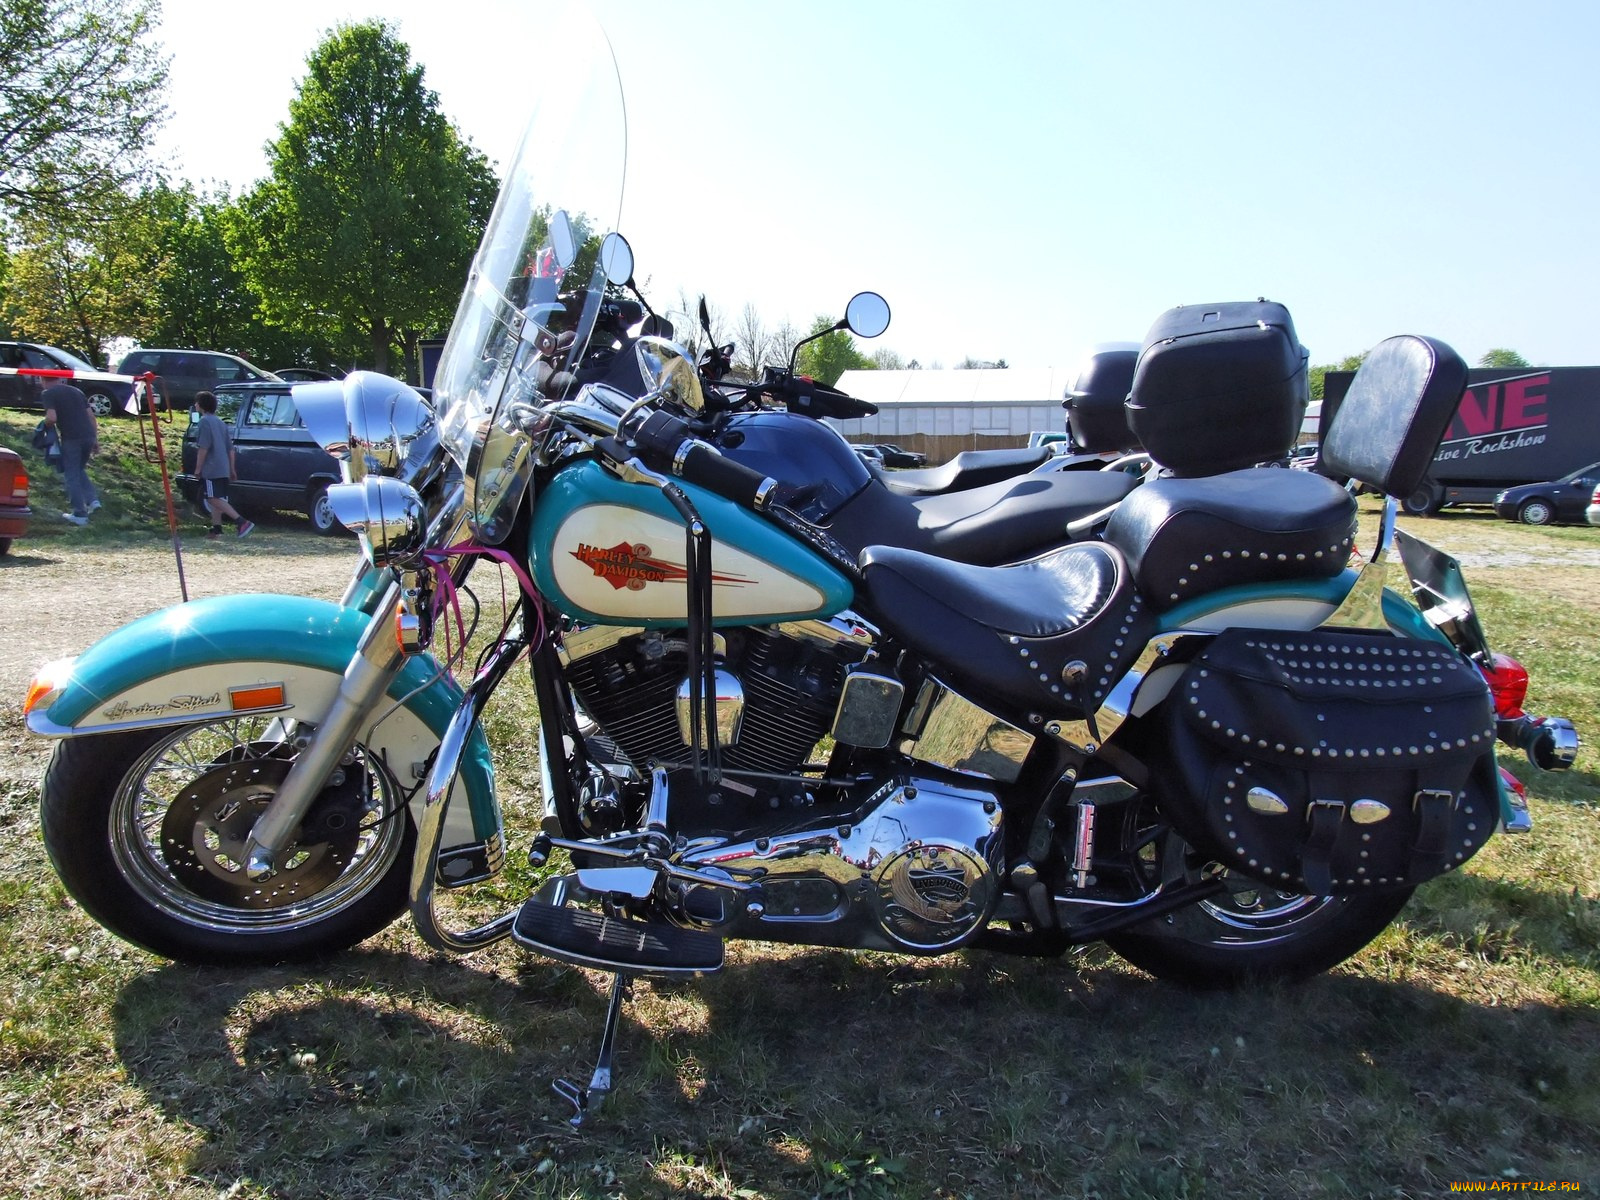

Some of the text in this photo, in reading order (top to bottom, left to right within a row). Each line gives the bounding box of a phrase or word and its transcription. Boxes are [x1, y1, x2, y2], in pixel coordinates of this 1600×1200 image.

[1433, 432, 1546, 461] ive Rockshow
[577, 543, 635, 564] HARLEY
[593, 561, 665, 582] DAVIDSON
[103, 692, 221, 720] Heritage Softail
